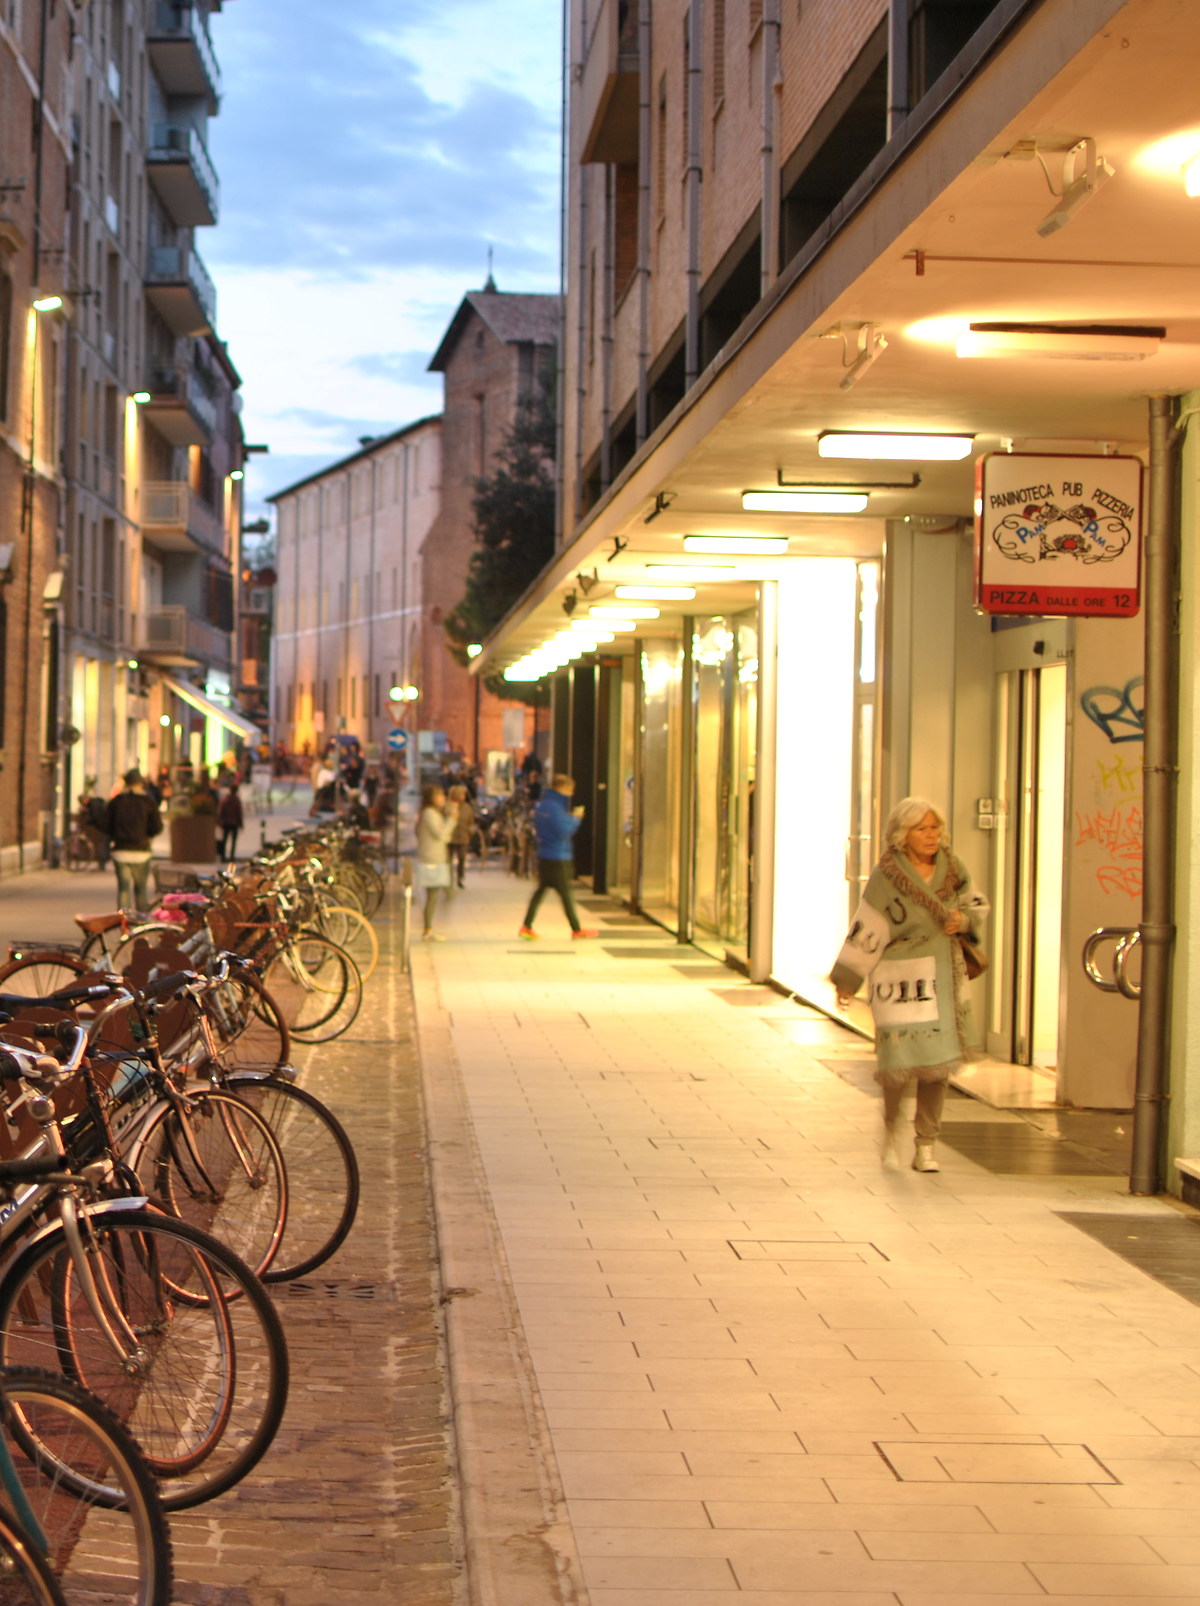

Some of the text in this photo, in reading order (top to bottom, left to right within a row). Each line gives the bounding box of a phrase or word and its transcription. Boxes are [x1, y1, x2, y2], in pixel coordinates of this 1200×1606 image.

[990, 482, 1135, 521] PANINOTECA PUB PIZZERIA
[989, 591, 1131, 608] PIZZA DALLE ORE 12
